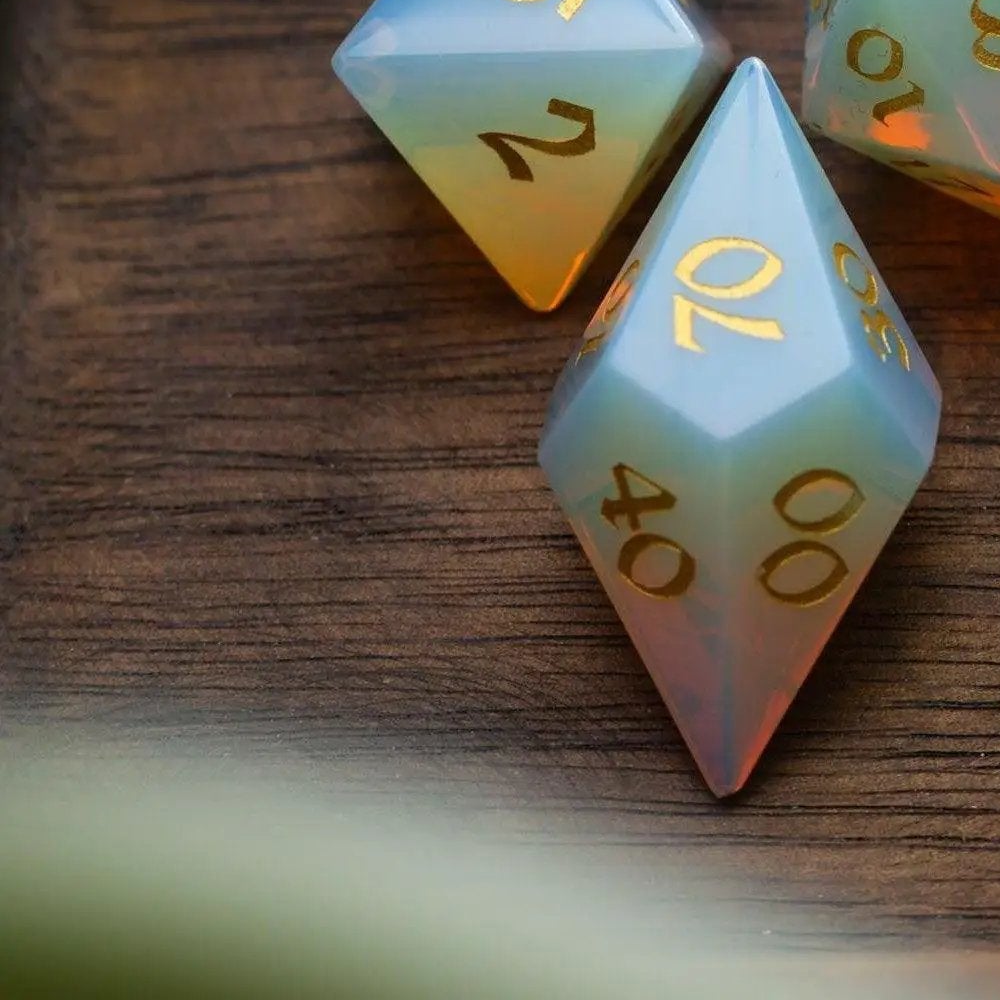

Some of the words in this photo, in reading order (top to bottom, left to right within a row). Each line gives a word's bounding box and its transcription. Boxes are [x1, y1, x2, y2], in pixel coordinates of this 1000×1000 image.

[846, 28, 925, 128] 10
[477, 98, 596, 183] 2
[673, 236, 784, 354] 70
[600, 461, 697, 600] 40
[755, 467, 867, 607] 00
